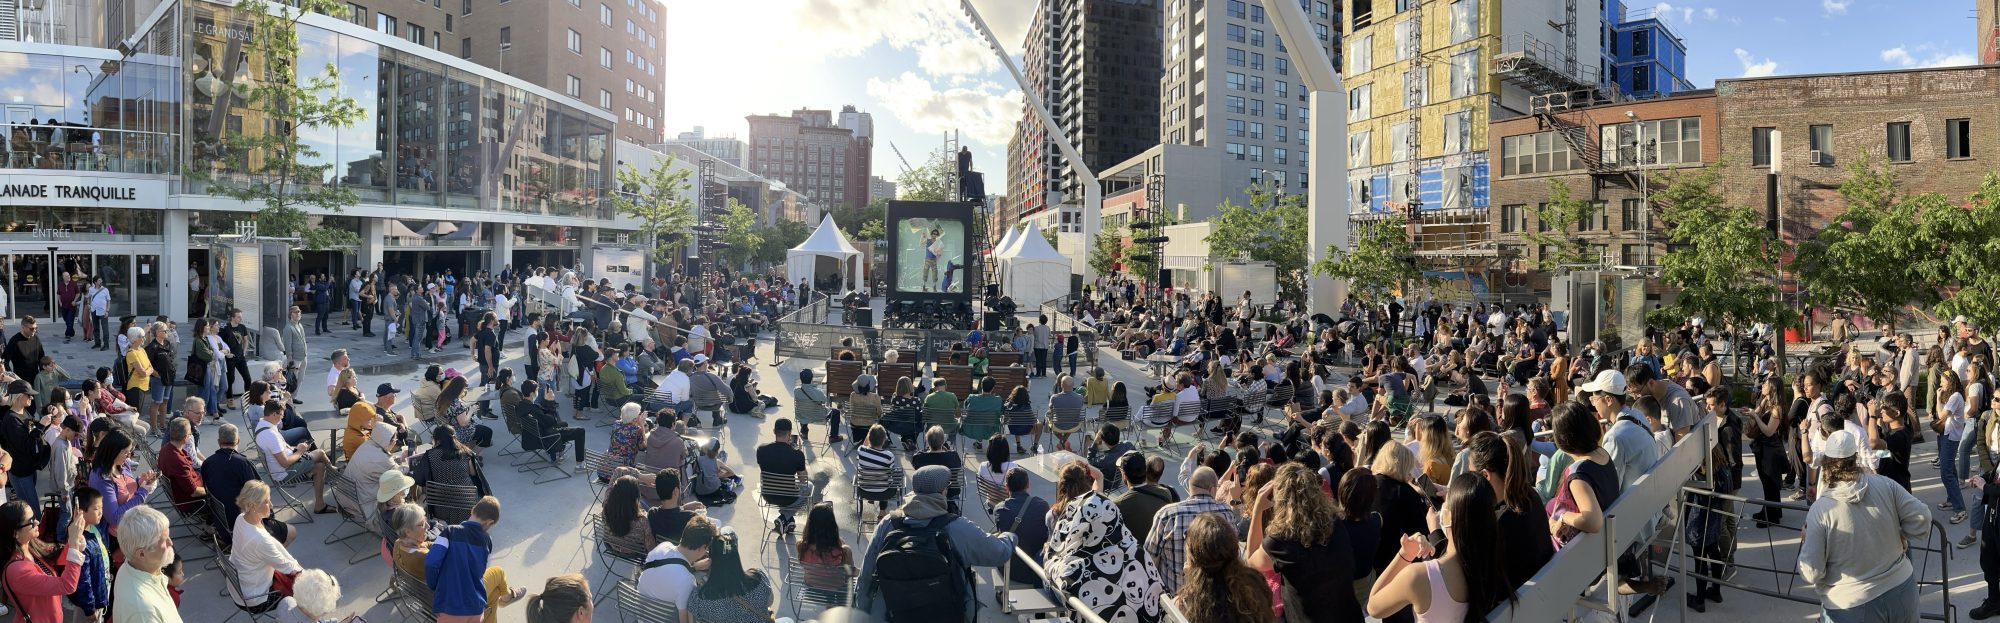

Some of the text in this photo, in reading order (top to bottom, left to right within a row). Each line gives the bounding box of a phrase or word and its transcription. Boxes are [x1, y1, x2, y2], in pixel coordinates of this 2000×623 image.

[205, 24, 238, 39] GRAND
[55, 185, 136, 201] TRANQUILLE
[32, 226, 71, 238] ENTRÉE
